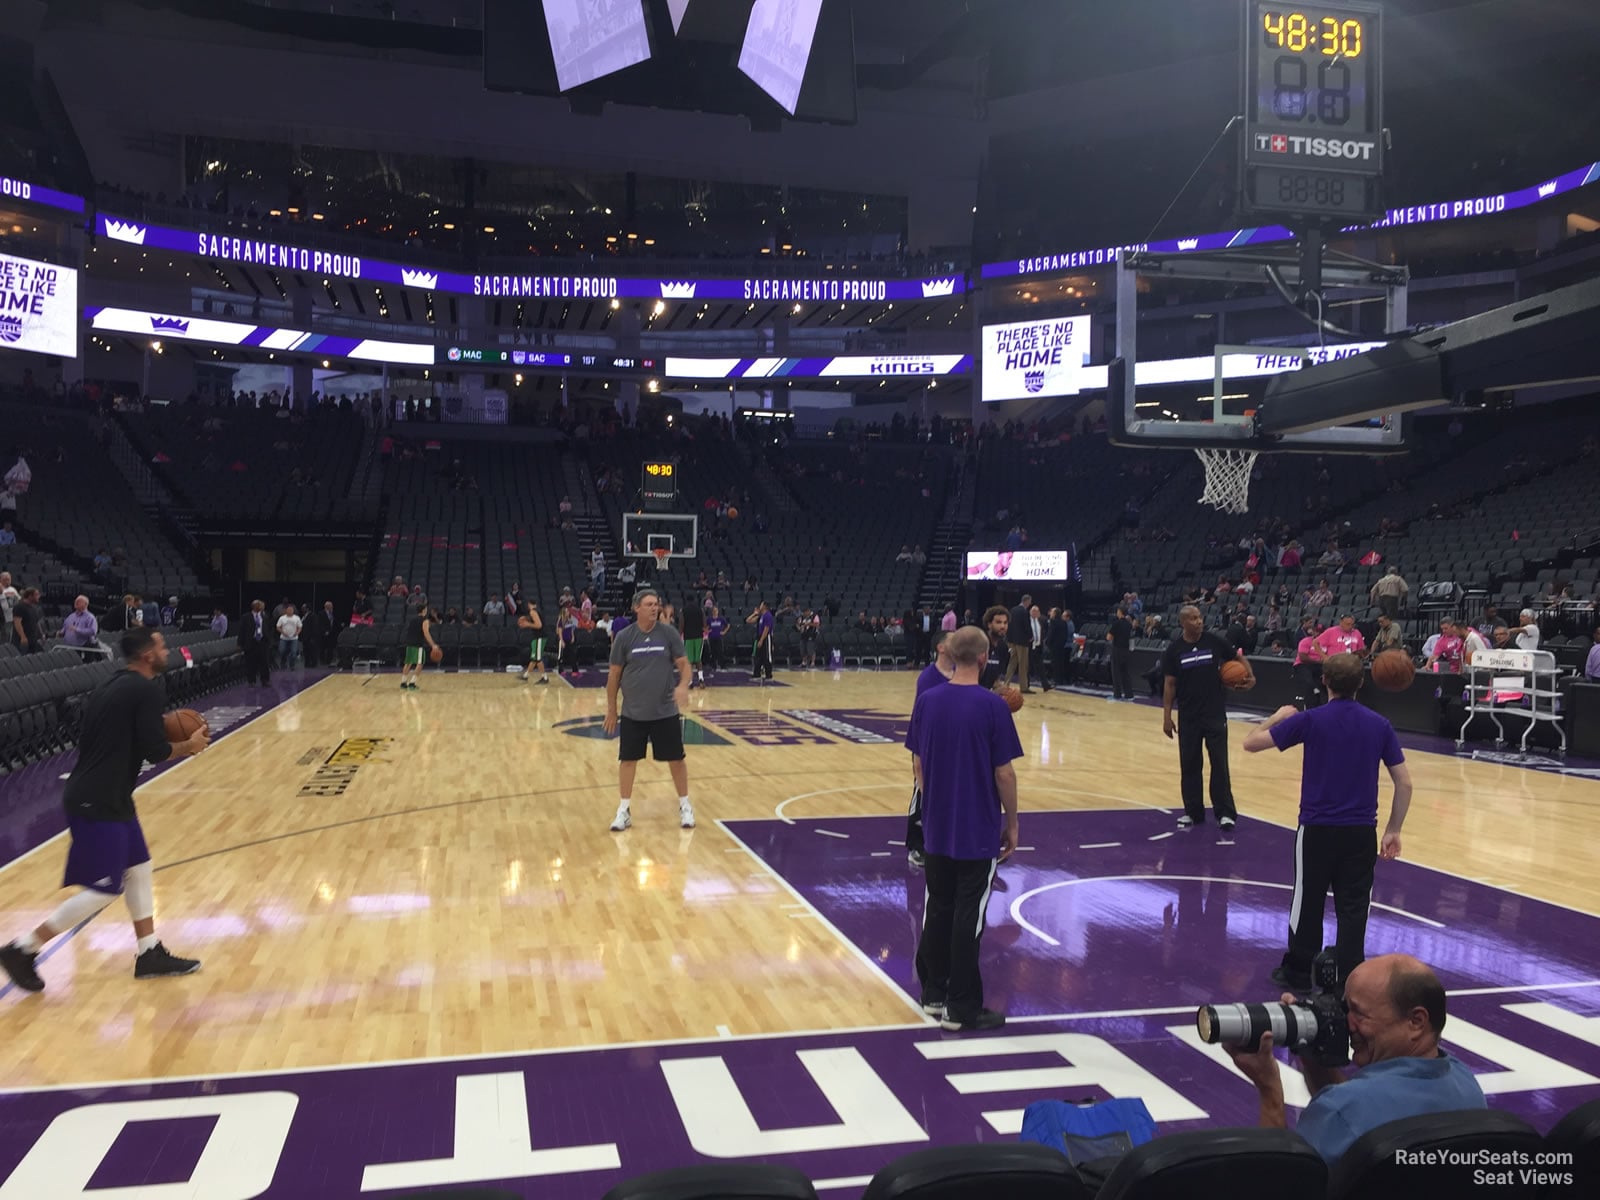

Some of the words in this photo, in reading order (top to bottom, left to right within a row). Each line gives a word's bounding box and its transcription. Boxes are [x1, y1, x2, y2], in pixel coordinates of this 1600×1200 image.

[1264, 12, 1361, 58] 48:30
[1289, 135, 1375, 160] TISSOT
[0, 177, 31, 199] OUD
[1454, 195, 1505, 217] PROUD
[199, 233, 308, 270] SACRAMENTO
[313, 251, 361, 279] PROUD
[1018, 248, 1103, 274] SACRAMENTO
[34, 266, 57, 282] NO
[20, 278, 56, 297] LIKE
[474, 275, 569, 296] SACRAMENTO
[573, 277, 617, 297] PROUD
[744, 279, 838, 300] SACRAMENTO
[843, 280, 886, 300] PROUD
[996, 324, 1051, 343] THERE'S
[1054, 321, 1074, 336] NO
[997, 337, 1039, 354] PLACE
[1043, 333, 1073, 348] LIKE
[463, 350, 482, 360] MAC
[500, 351, 508, 361] 0
[528, 353, 546, 364] SAC
[563, 354, 571, 365] 0
[581, 356, 597, 365] 1ST
[870, 362, 935, 374] KINGS
[1005, 347, 1063, 371] HOME
[646, 464, 673, 476] 48:30
